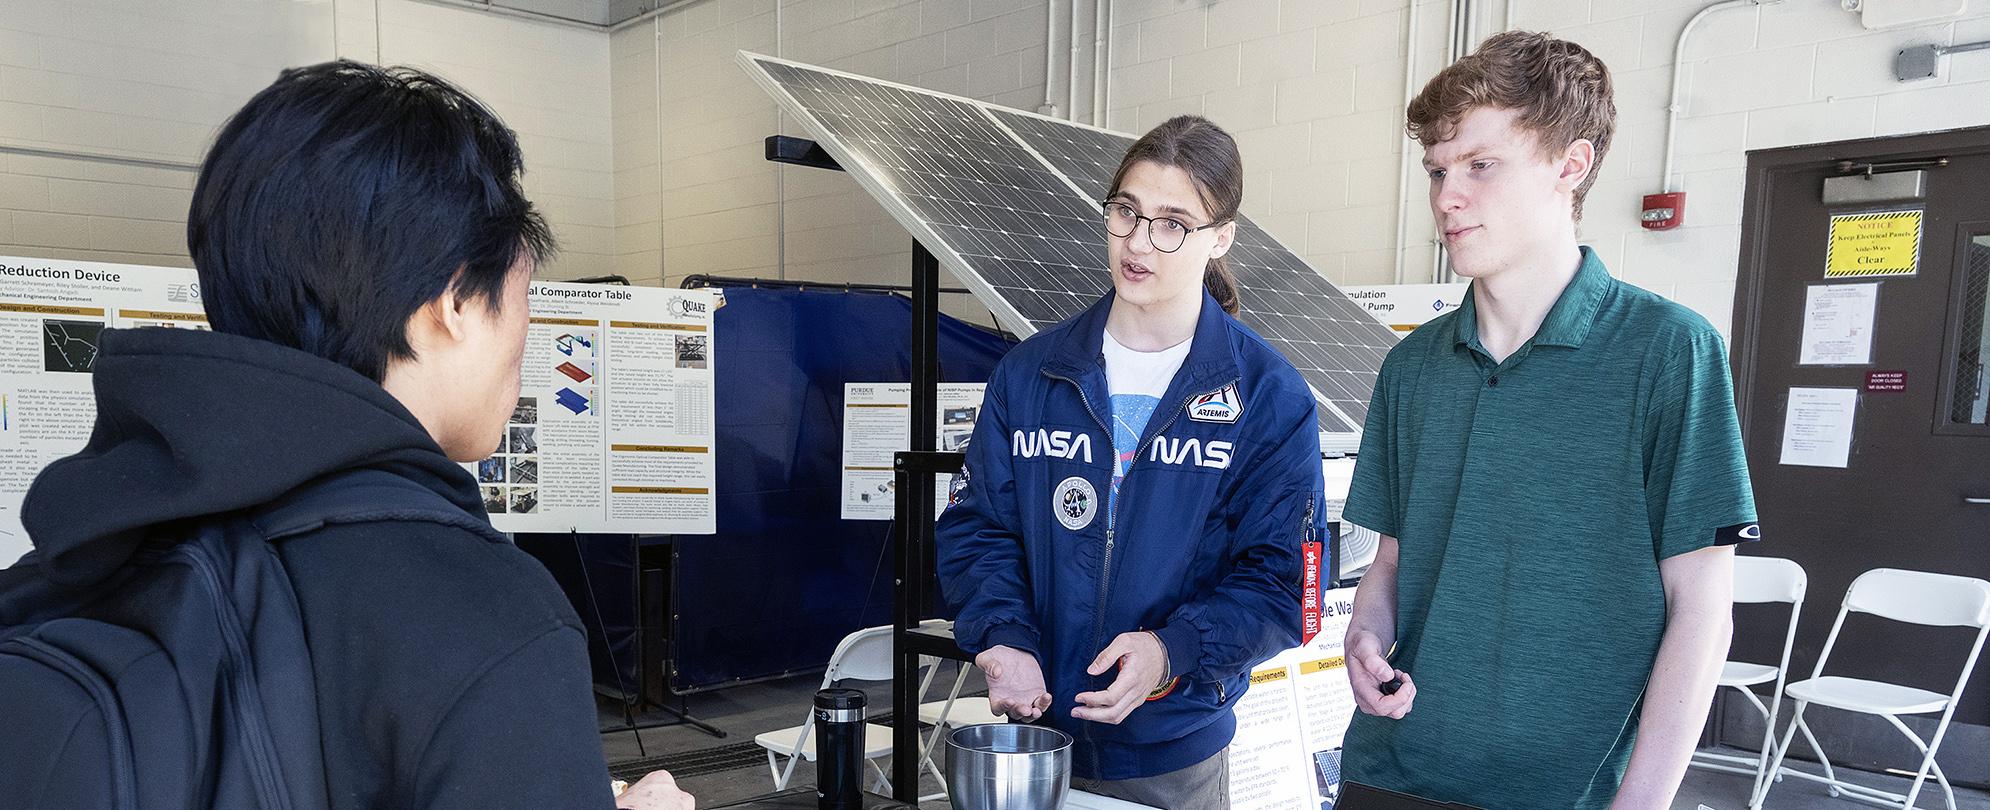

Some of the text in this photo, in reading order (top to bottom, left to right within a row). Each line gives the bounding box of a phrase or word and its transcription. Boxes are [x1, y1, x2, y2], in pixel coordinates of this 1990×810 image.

[1649, 220, 1666, 228] FIRE
[1858, 221, 1895, 229] NOTICE
[1857, 257, 1885, 265] Clear
[0, 264, 121, 282] Reduction Device
[540, 287, 602, 298] Comparator
[605, 290, 632, 300] Table
[37, 306, 80, 314] Construction
[682, 300, 705, 313] QUAKE
[1368, 302, 1395, 312] Pump
[1197, 409, 1229, 418] ARTEMIS
[1012, 428, 1092, 463] NASA
[1062, 481, 1091, 494] APOLLO
[1305, 564, 1317, 634] REMOVE BEFORE FLIGHT
[1250, 669, 1286, 683] Requirements
